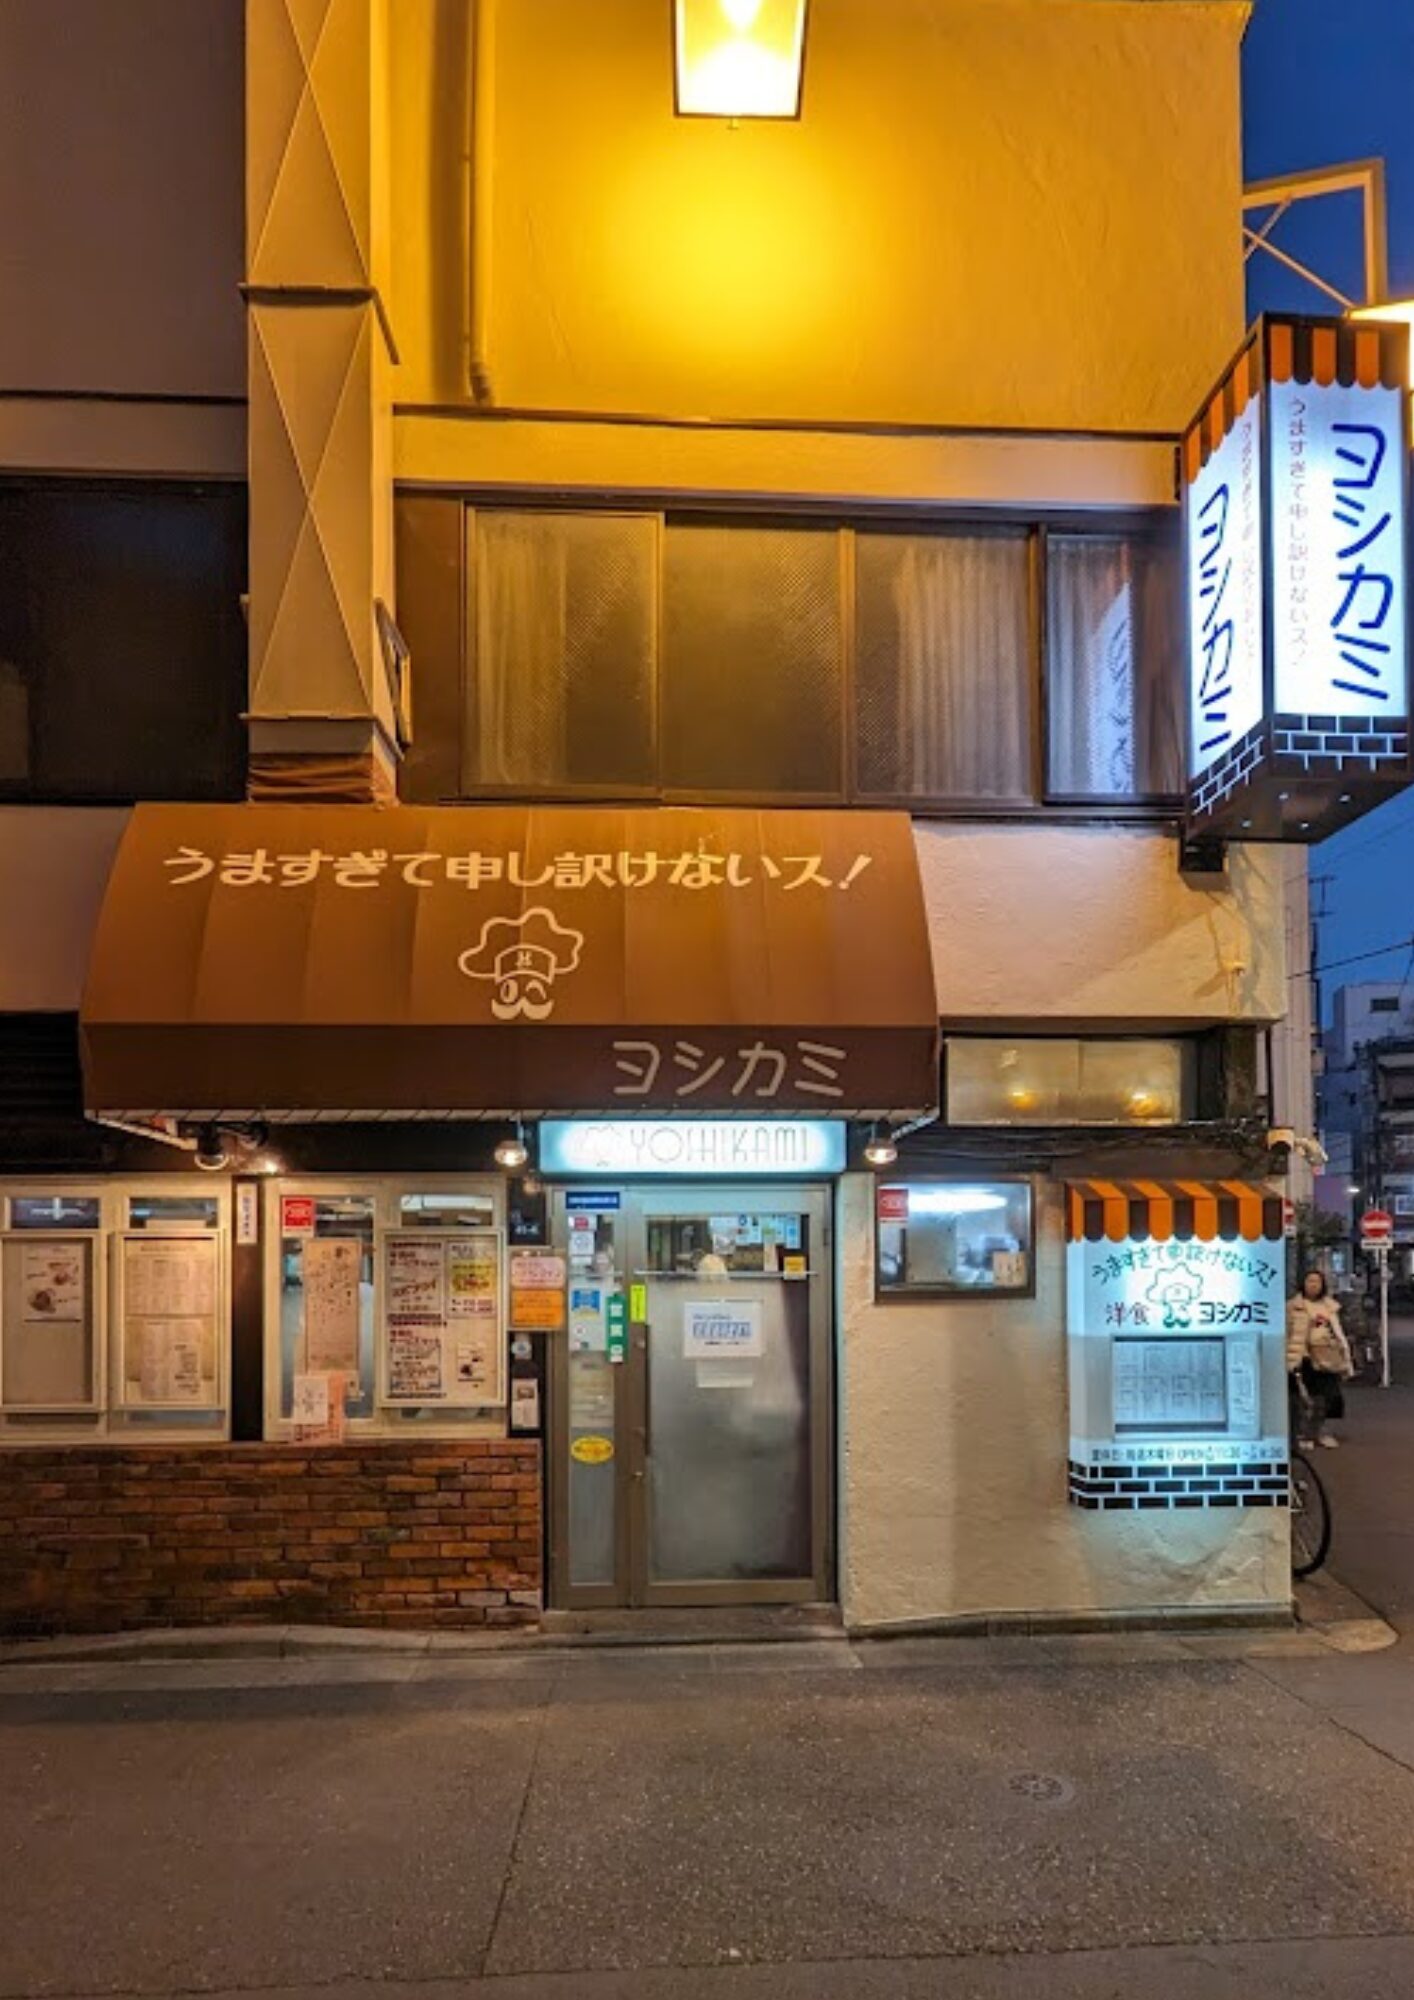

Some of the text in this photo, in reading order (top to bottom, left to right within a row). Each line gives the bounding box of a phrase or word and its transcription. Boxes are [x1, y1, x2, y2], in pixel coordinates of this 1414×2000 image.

[1332, 422, 1394, 702] ヨシカミ
[1199, 482, 1234, 752] ヨシカミ
[612, 1040, 847, 1098] ヨシカミ
[630, 1126, 808, 1164] YOSHIKAMI
[1106, 1302, 1269, 1328] 洋食 ヨシカミ
